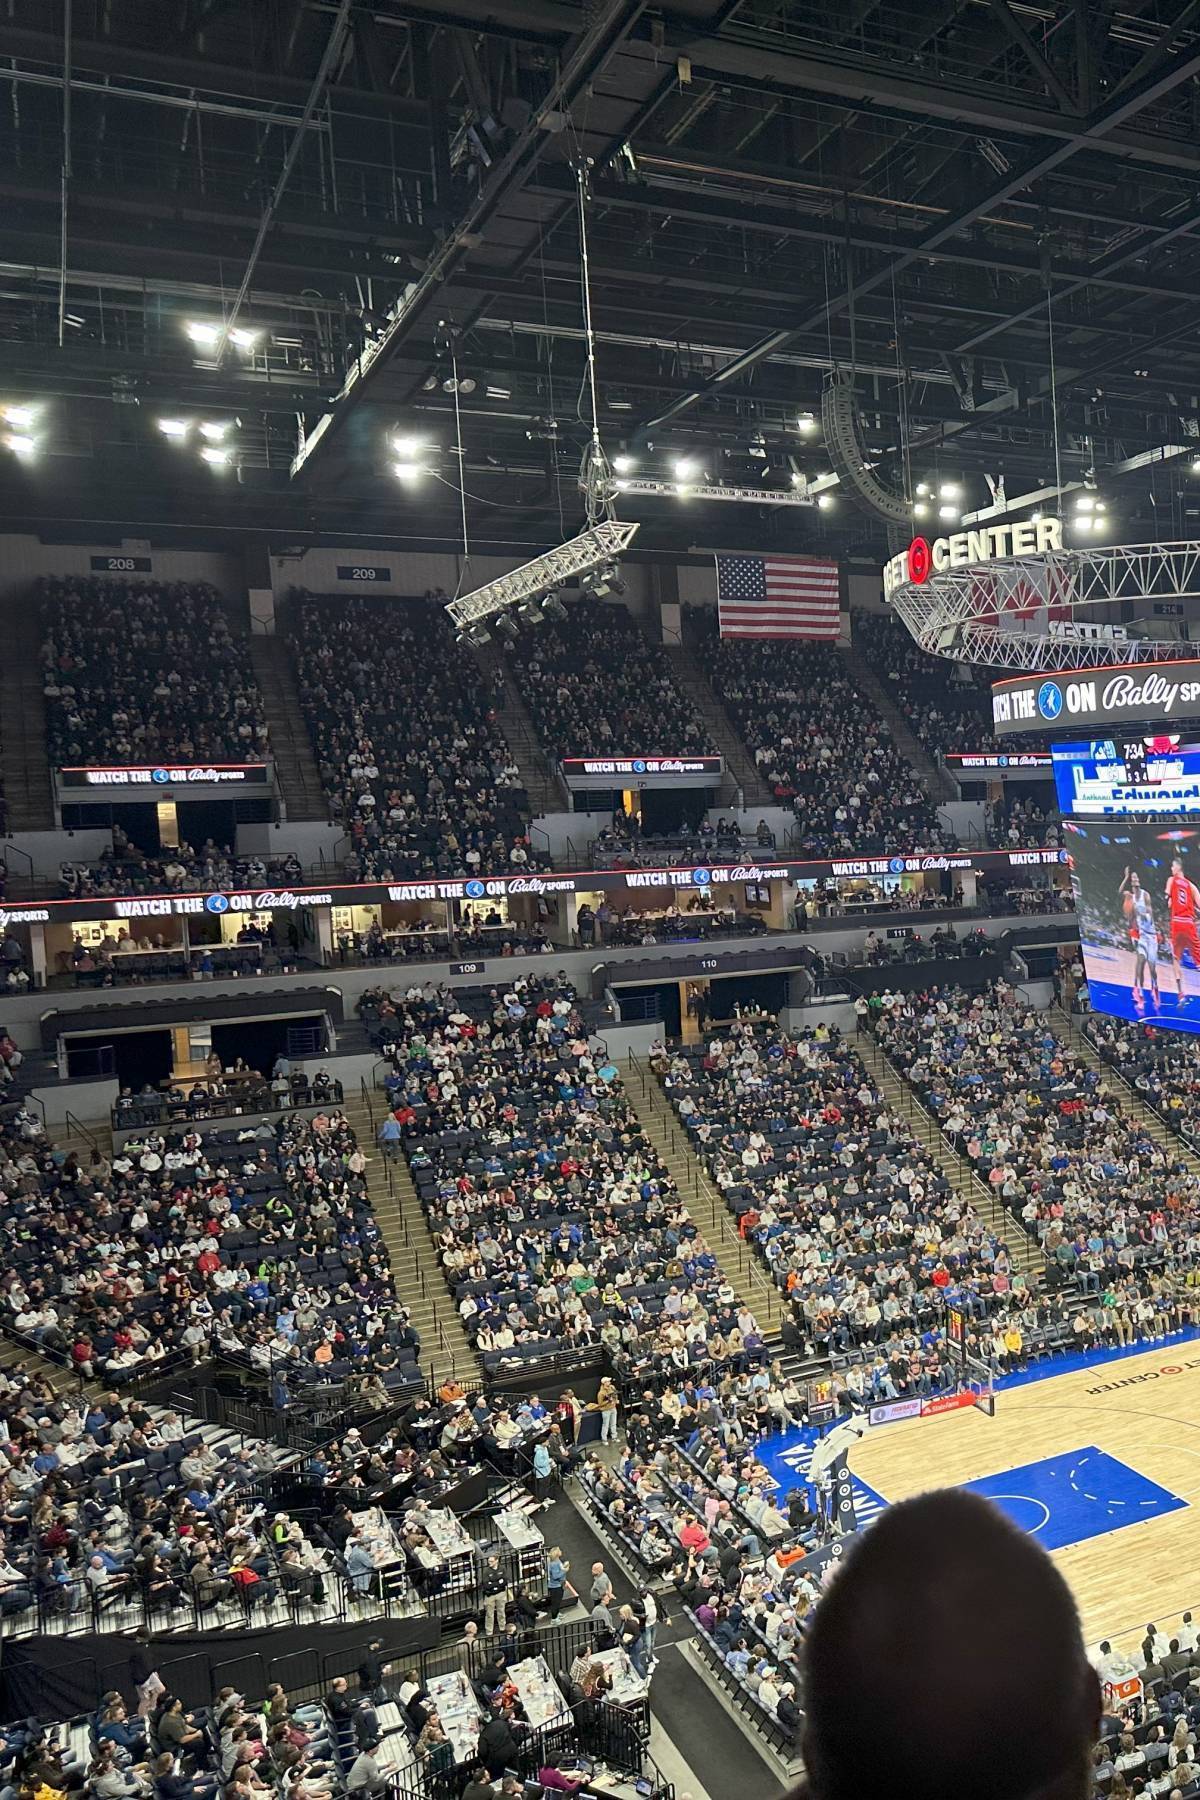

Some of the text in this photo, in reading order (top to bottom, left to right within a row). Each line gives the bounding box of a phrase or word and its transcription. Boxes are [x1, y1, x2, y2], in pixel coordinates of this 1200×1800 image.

[931, 517, 1065, 571] CENTER
[108, 558, 135, 570] 208
[352, 568, 376, 580] 209
[1011, 689, 1036, 719] THE
[1066, 681, 1097, 713] ON
[1102, 673, 1180, 713] Bally
[1123, 744, 1144, 759] 7:34
[584, 762, 615, 773] WATCH
[616, 762, 633, 772] THE
[646, 762, 659, 771] ON
[661, 760, 686, 773] Bally
[961, 757, 985, 767] WATCH
[986, 757, 998, 766] THE
[1009, 756, 1018, 766] ON
[87, 770, 128, 784] WATCH
[130, 769, 152, 783] THE
[169, 769, 187, 782] ON
[188, 768, 222, 783] Bally
[1134, 771, 1141, 783] 3
[1009, 851, 1058, 865] WATCH THE
[832, 857, 972, 875] WATCH THE ON Bally SPORTS
[626, 866, 788, 887] WATCH THE ON Bally SPORTS
[388, 878, 575, 901] WATCH THE ON Bally SPORTS
[115, 892, 333, 918] WATCH THE ON Bally SPORTS
[12, 909, 50, 923] SPORTS
[893, 929, 906, 937] 111
[459, 964, 477, 973] 109
[701, 959, 717, 968] 110
[1085, 1372, 1161, 1395] CENTER
